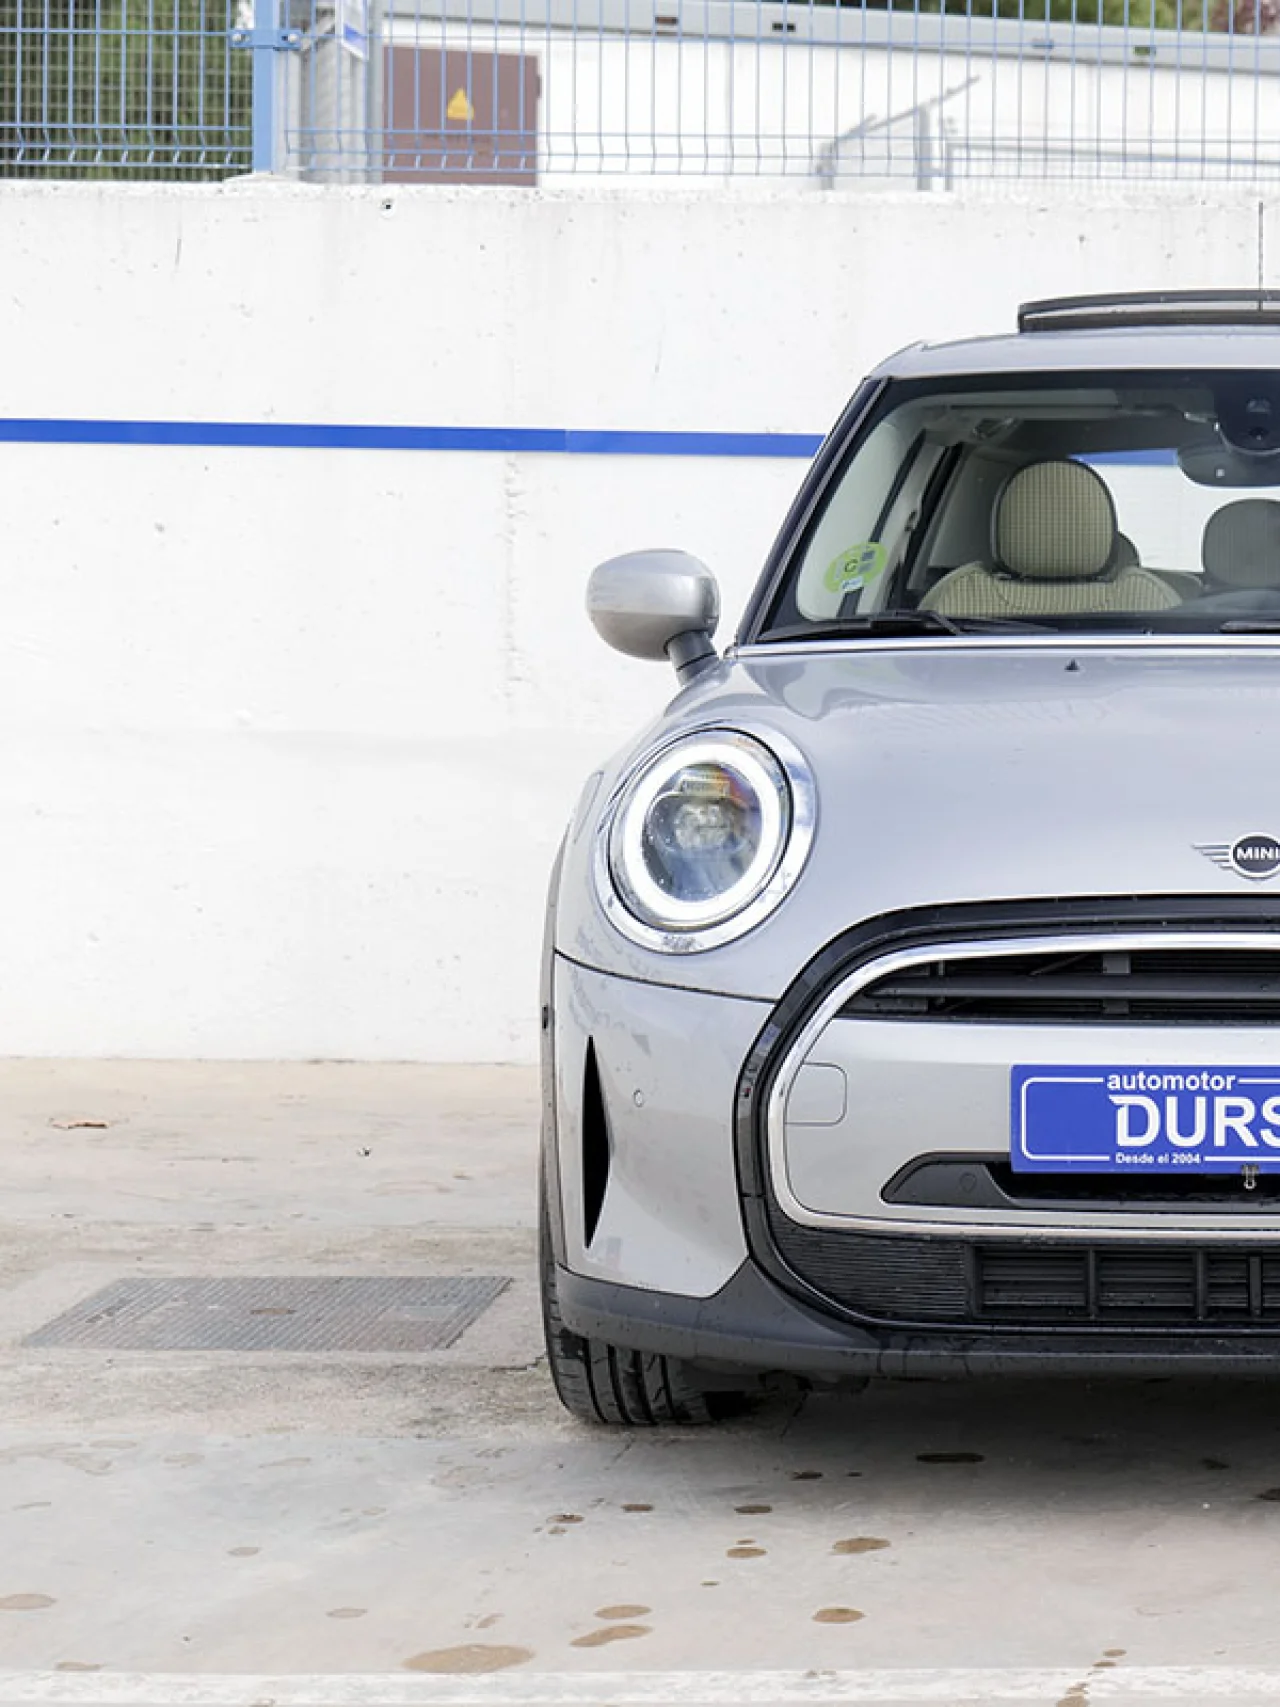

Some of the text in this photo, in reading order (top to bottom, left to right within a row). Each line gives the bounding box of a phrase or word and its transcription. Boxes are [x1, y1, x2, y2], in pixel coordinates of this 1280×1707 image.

[1107, 1070, 1236, 1091] automotor
[1115, 1152, 1201, 1165] Desde el 2004
